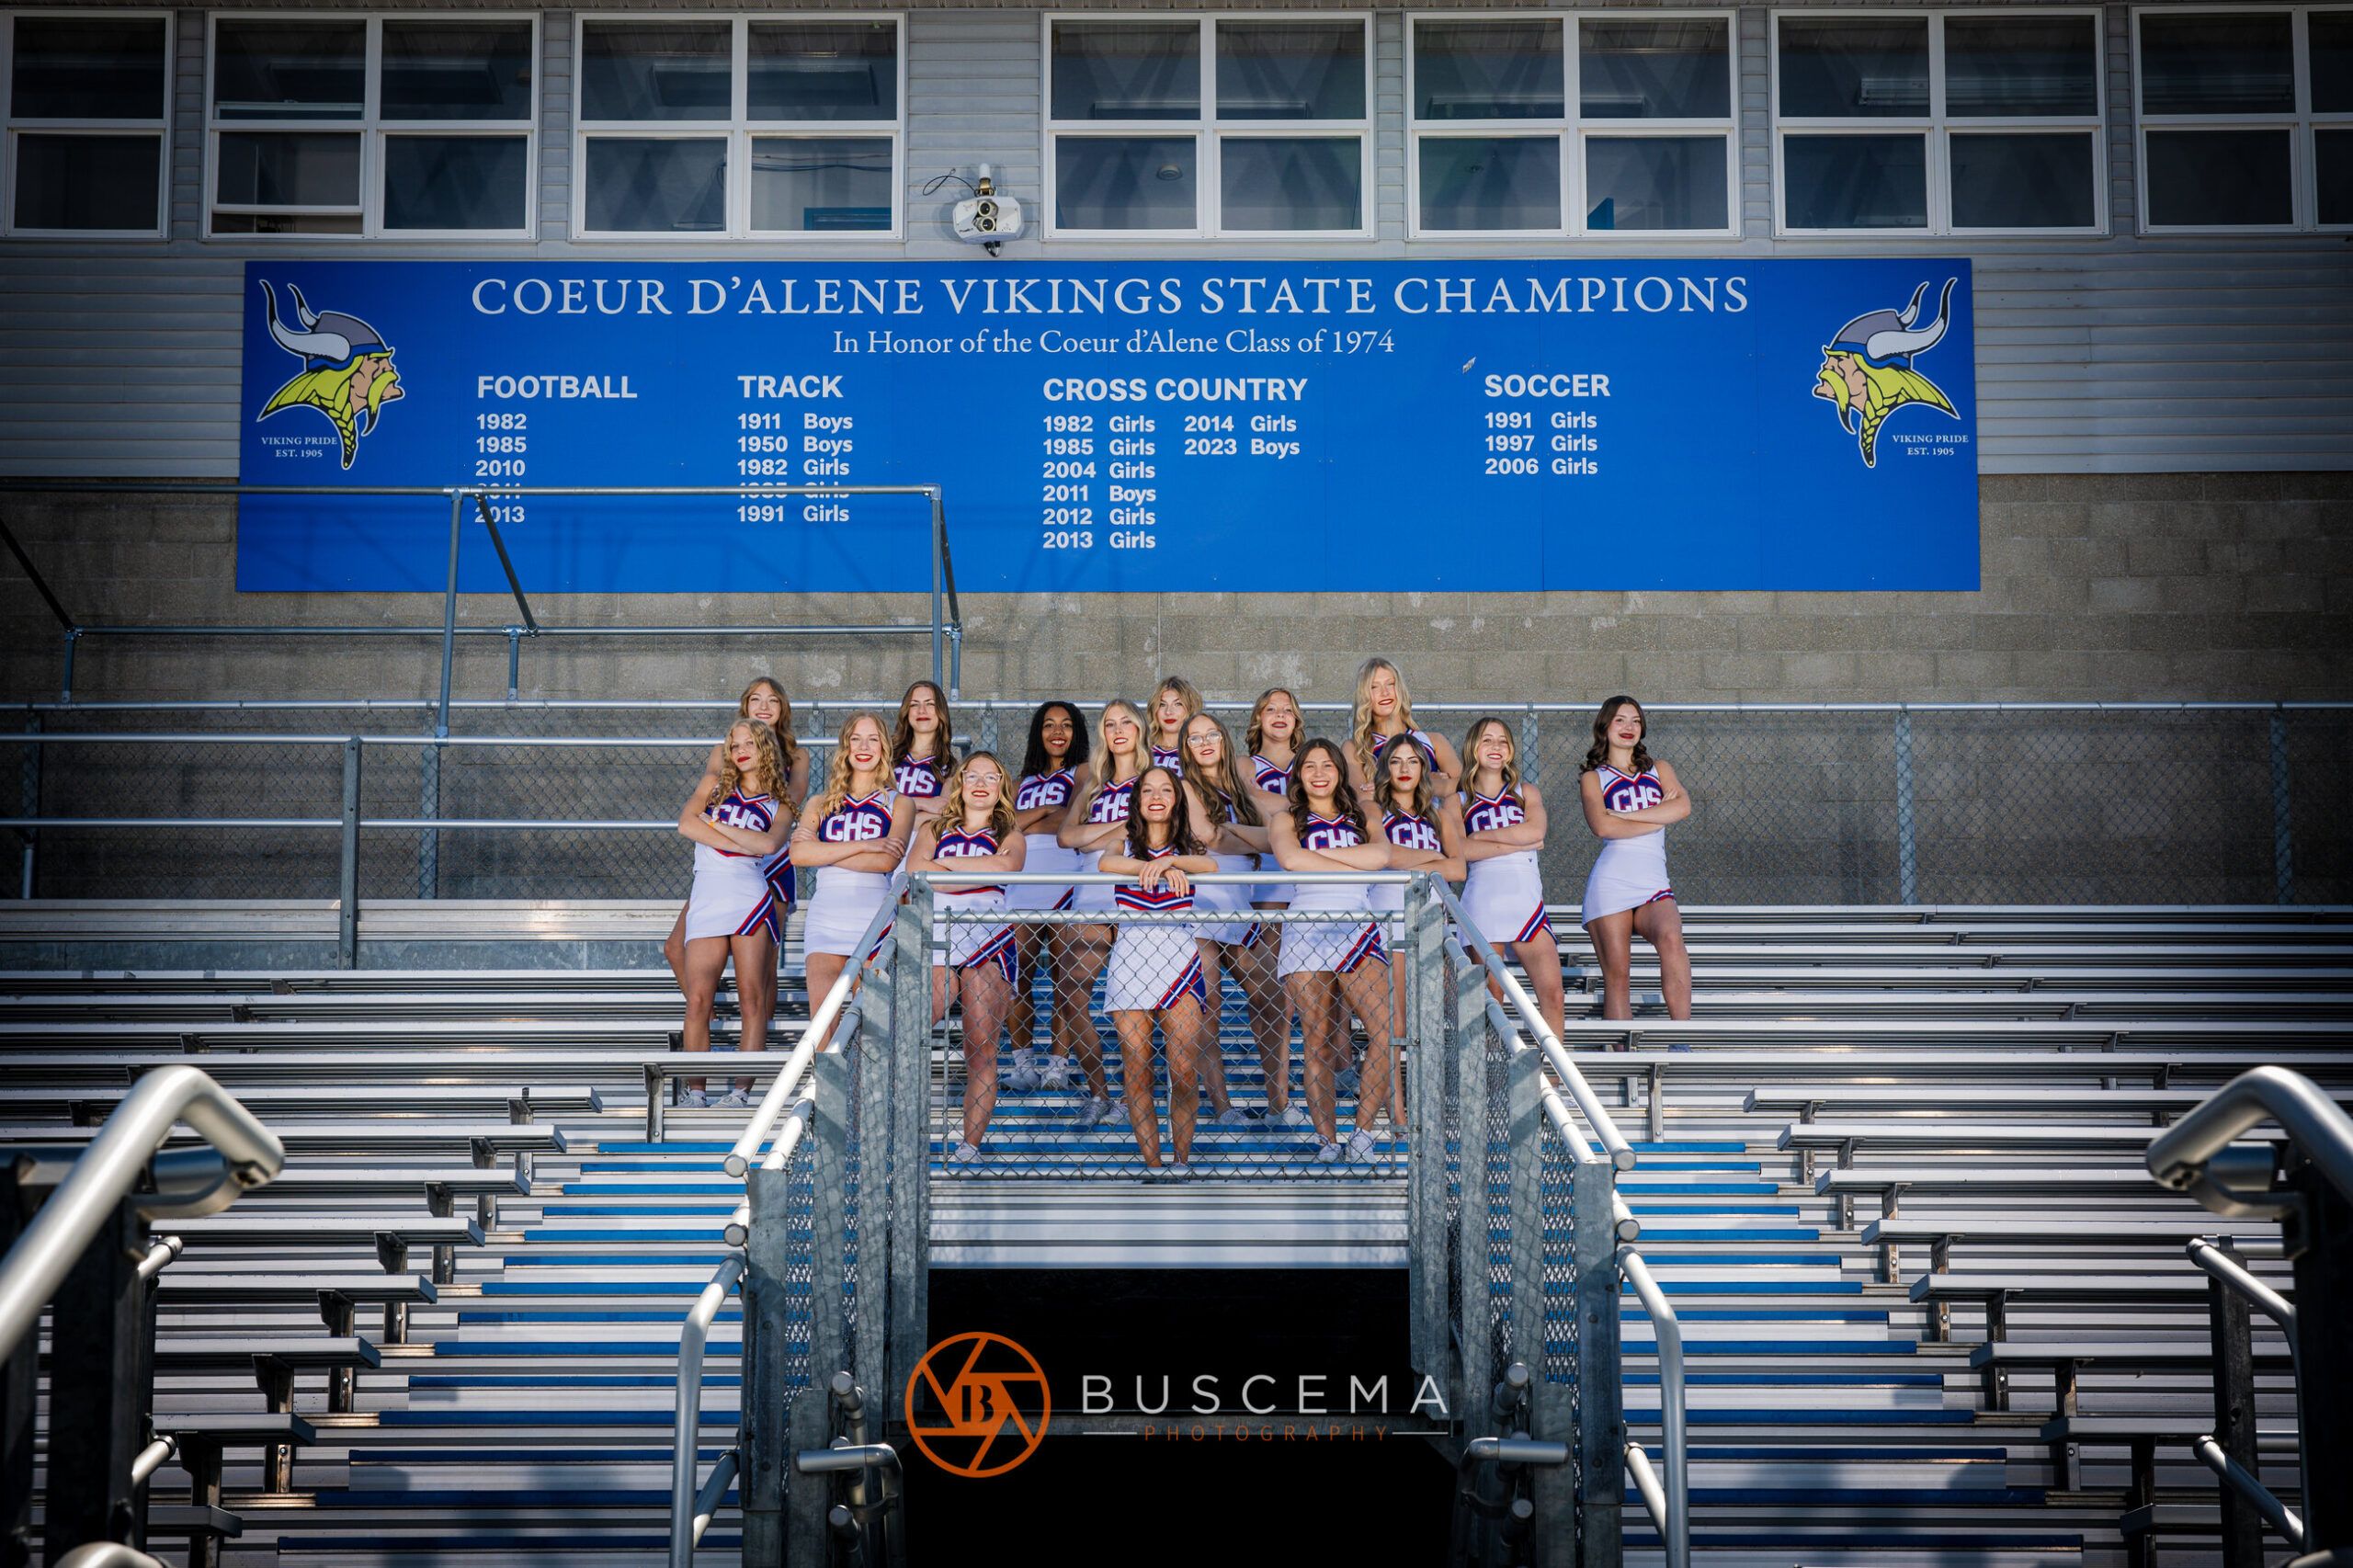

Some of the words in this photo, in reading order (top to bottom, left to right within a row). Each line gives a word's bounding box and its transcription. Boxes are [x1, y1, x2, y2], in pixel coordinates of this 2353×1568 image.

[472, 278, 673, 315] COEUR
[688, 277, 924, 314] D'ALENE
[939, 278, 1182, 314] VIKINGS
[1200, 278, 1376, 314] STATE
[1393, 277, 1747, 314] CHAMPIONS
[833, 331, 859, 353] In
[867, 331, 953, 354] Honor
[960, 328, 989, 353] of
[993, 328, 1032, 353] the
[1040, 330, 1120, 353] Coeur
[1126, 328, 1218, 353] d'Alene
[1225, 328, 1290, 353] Class
[1297, 328, 1327, 353] of
[1334, 328, 1395, 354] 1974
[477, 375, 638, 399] FOOTBALL
[737, 375, 844, 398] TRACK
[1043, 378, 1148, 402] CROSS
[1154, 378, 1308, 402] COUNTRY
[1484, 374, 1610, 398] SOCCER
[476, 413, 527, 430] 1982
[737, 413, 780, 429] 1911
[803, 413, 853, 434] Boys
[1043, 415, 1094, 433] 1982
[1108, 415, 1155, 433] Girls
[1184, 415, 1234, 432] 2014
[1250, 415, 1297, 432] Girls
[1484, 412, 1531, 429] 1991
[1551, 411, 1597, 429] Girls
[261, 437, 302, 445] VIKING
[304, 437, 337, 445] PRIDE
[476, 436, 527, 453] 1985
[737, 436, 789, 453] 1950
[803, 436, 853, 457] Boys
[1043, 438, 1094, 456] 1985
[1108, 437, 1155, 456] Girls
[1184, 438, 1237, 456] 2023
[1251, 437, 1301, 460] Boys
[1484, 435, 1535, 452] 1997
[1551, 434, 1597, 452] Girls
[1892, 435, 1933, 443] VIKING
[1935, 435, 1969, 443] PRIDE
[276, 449, 298, 458] EST.
[301, 449, 324, 458] 1905
[1907, 447, 1929, 456] EST.
[1932, 447, 1955, 456] 1905
[475, 459, 526, 477] 2010
[737, 459, 788, 476] 1982
[803, 458, 850, 476] Girls
[1042, 461, 1097, 479] 2004
[1108, 460, 1155, 479] Girls
[1484, 458, 1540, 475] 2006
[1552, 457, 1598, 475] Girls
[1042, 484, 1088, 502] 2011
[1108, 484, 1156, 506] Boys
[474, 506, 525, 523] 2013
[737, 505, 784, 522] 1991
[802, 504, 849, 522] Girls
[1042, 507, 1093, 525] 2012
[1108, 507, 1156, 526] Girls
[1042, 530, 1094, 549] 2013
[1108, 530, 1156, 549] Girls
[1017, 781, 1066, 811] CHS
[1612, 785, 1662, 812] CHS
[825, 811, 883, 842] CHS
[1471, 805, 1525, 832] CHS
